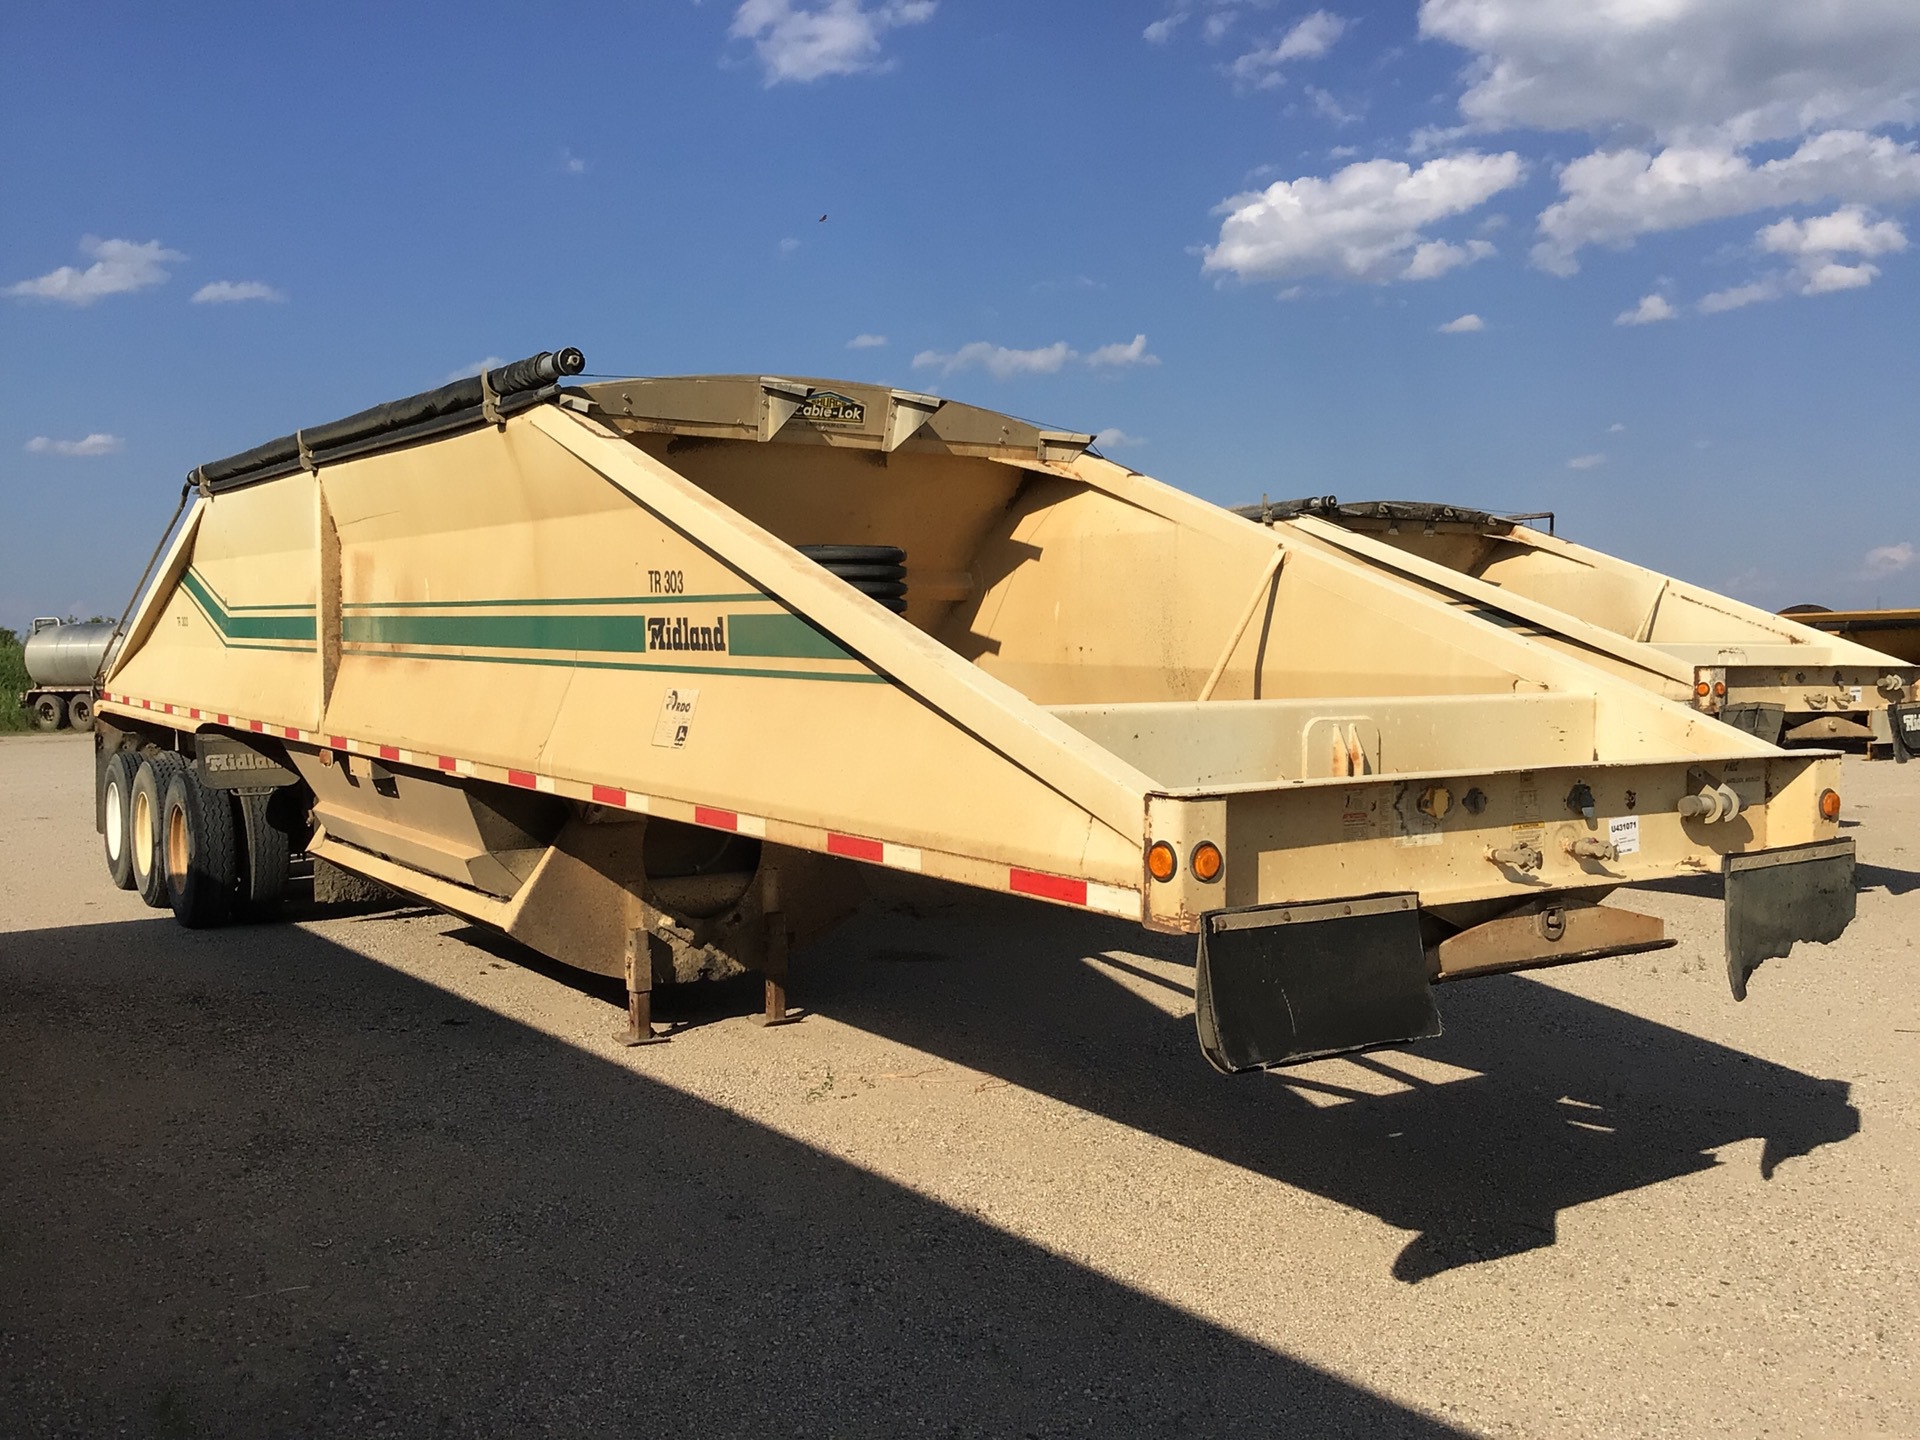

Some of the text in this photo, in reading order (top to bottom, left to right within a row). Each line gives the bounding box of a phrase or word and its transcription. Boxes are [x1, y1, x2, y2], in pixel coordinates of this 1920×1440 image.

[648, 570, 684, 594] TR 303
[647, 616, 726, 651] Midland
